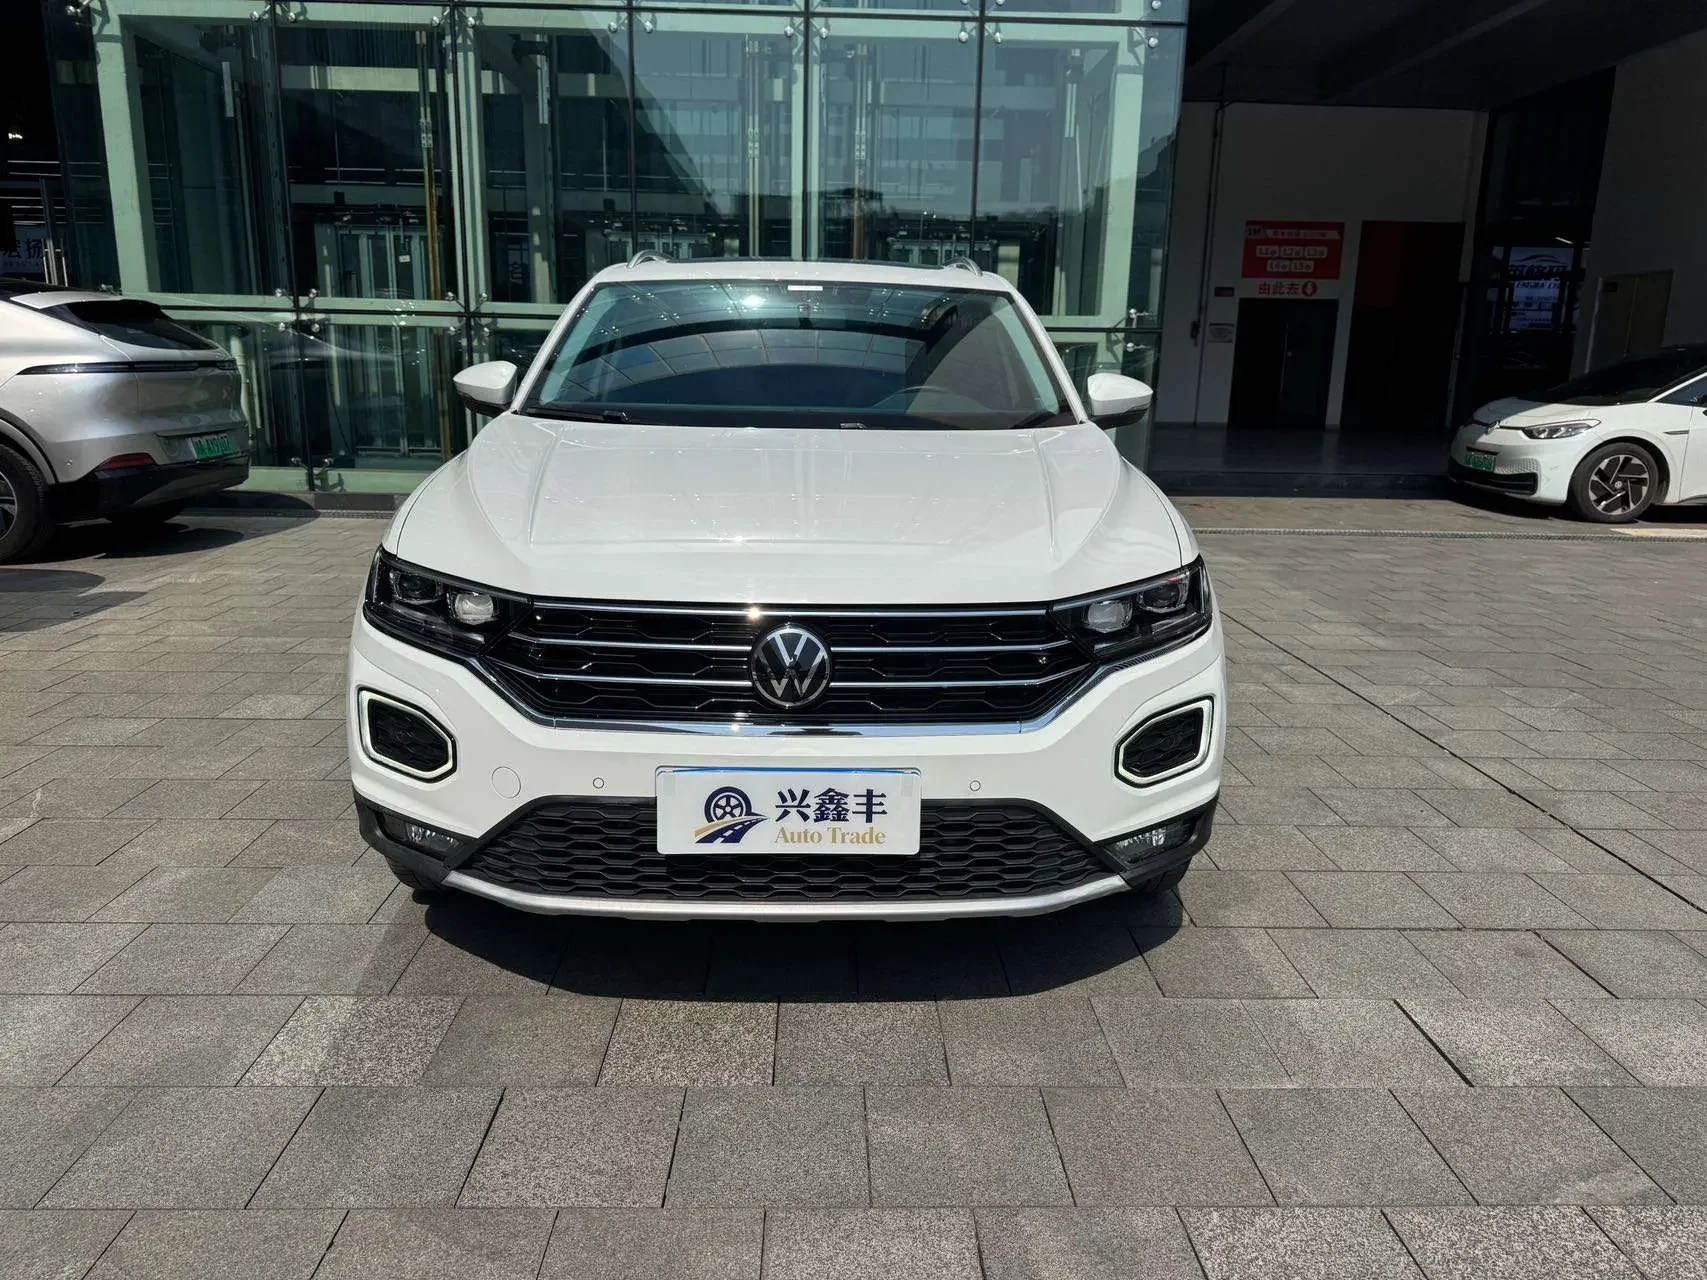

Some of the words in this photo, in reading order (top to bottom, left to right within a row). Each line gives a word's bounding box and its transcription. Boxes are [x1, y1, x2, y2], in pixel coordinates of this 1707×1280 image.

[775, 787, 888, 824] 兴鑫丰
[775, 826, 823, 845] Auto
[826, 826, 887, 845] Trade
